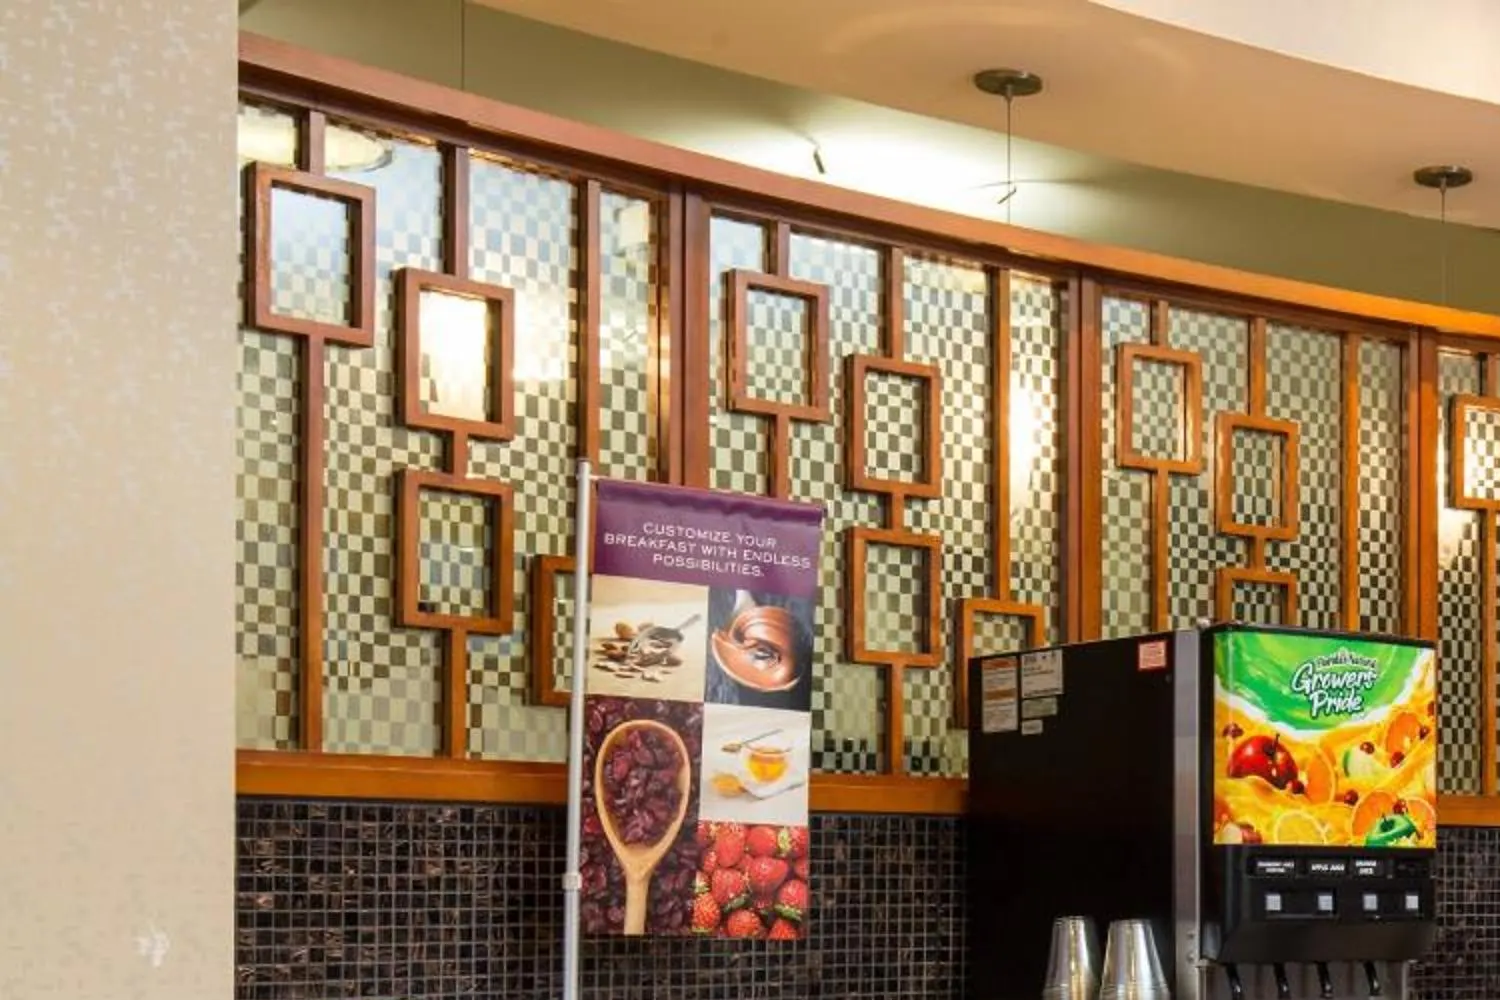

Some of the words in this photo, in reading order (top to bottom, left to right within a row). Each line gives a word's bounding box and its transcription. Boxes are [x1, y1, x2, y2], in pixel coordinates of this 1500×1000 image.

[643, 521, 731, 543] CUSTOMIZE
[736, 534, 777, 549] YOUR
[604, 533, 697, 553] BREAKFAST
[701, 545, 737, 559] WITH
[743, 549, 811, 569] ENDLESS
[652, 553, 765, 577] POSSIBILITIES.
[1309, 688, 1363, 717] Pride
